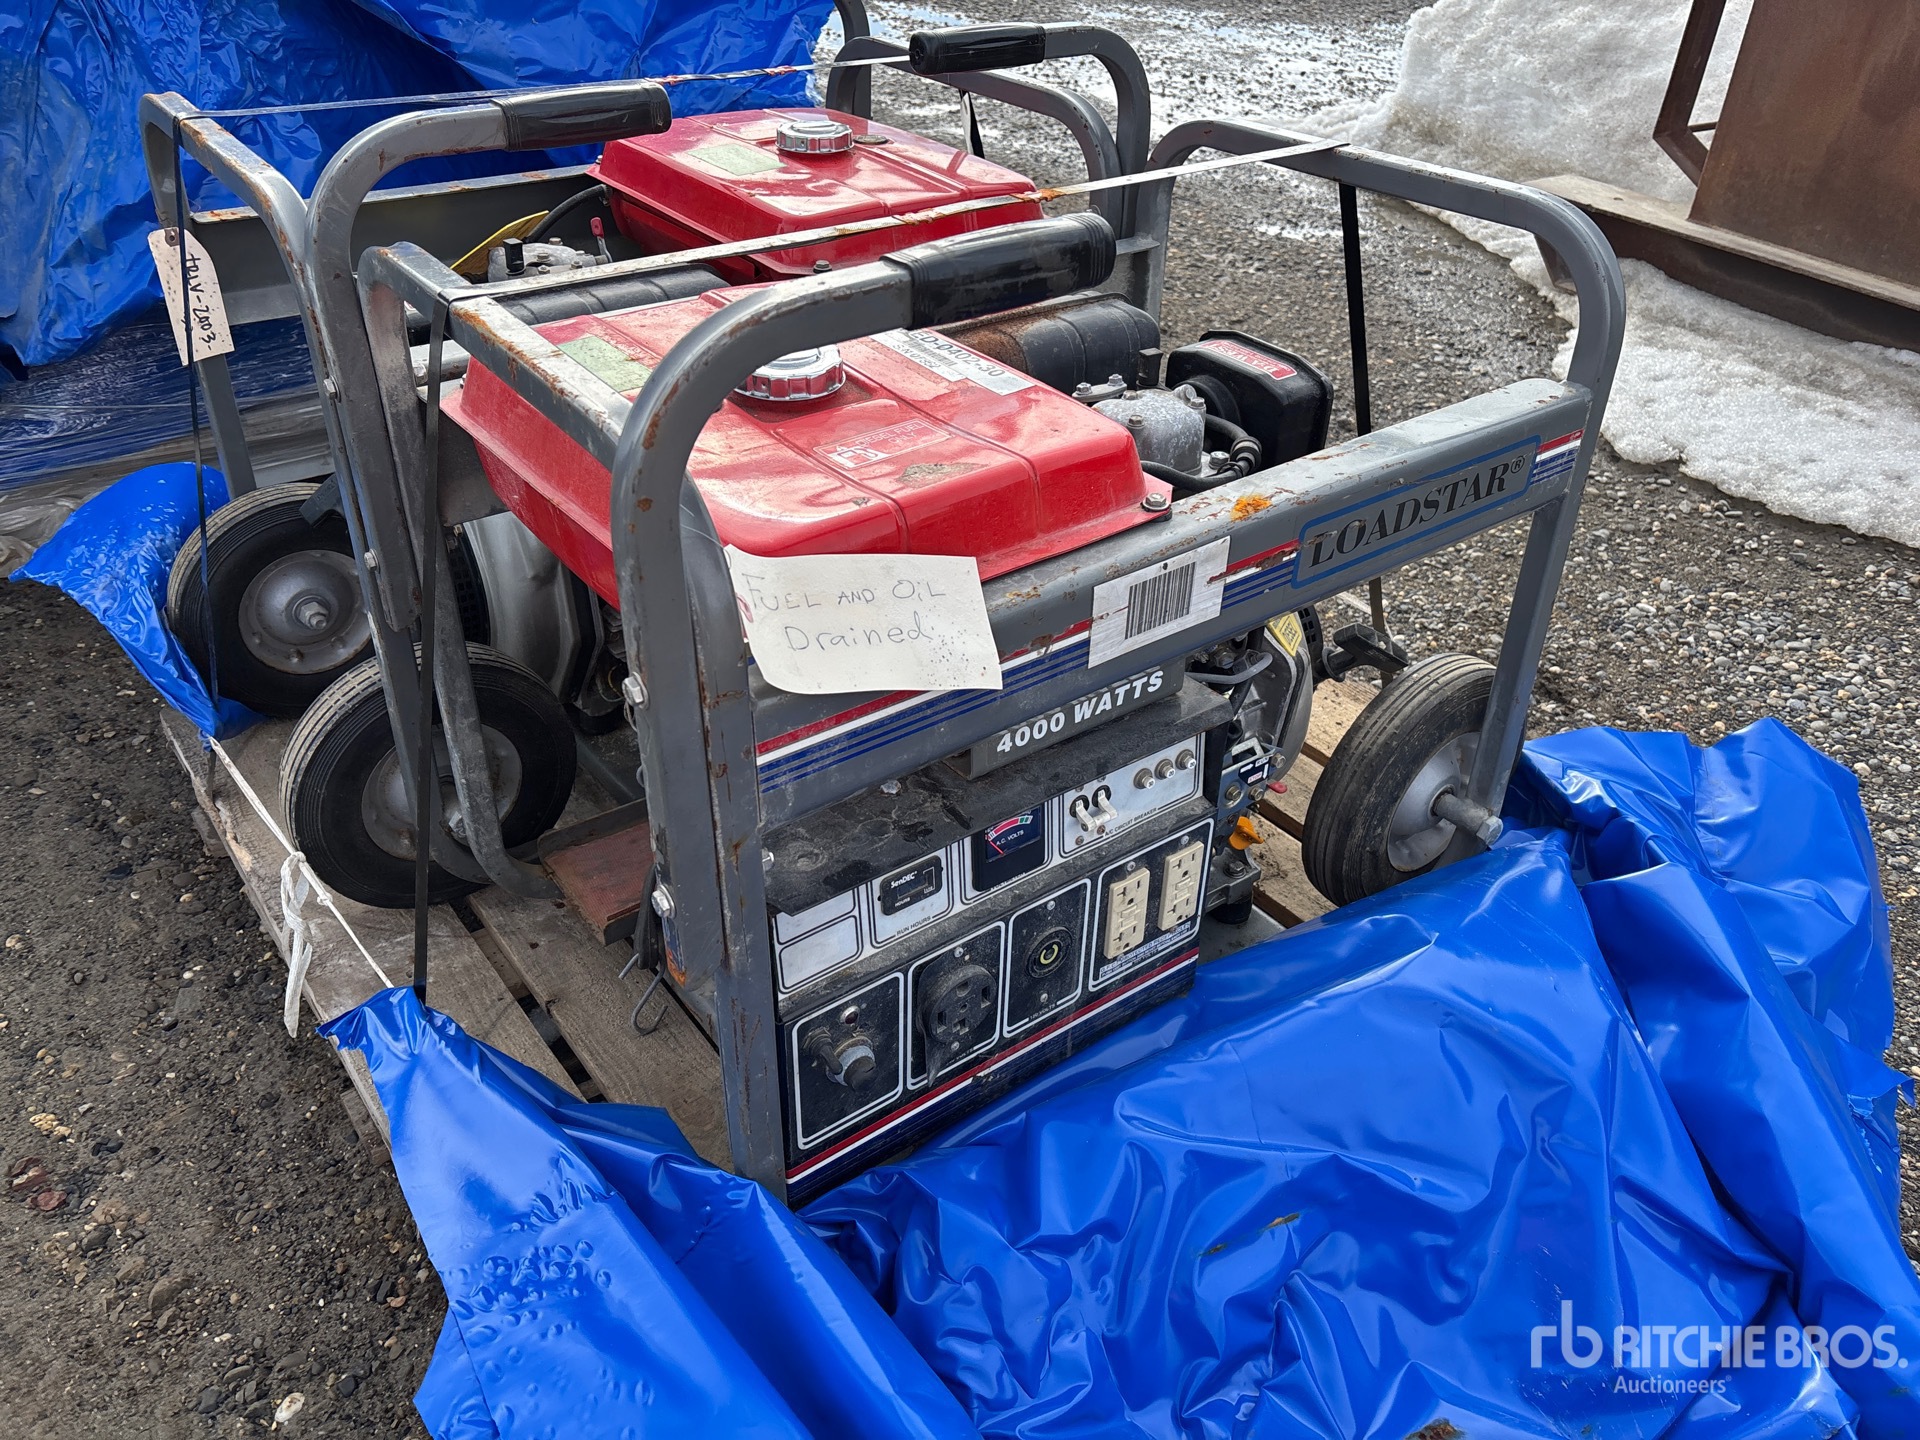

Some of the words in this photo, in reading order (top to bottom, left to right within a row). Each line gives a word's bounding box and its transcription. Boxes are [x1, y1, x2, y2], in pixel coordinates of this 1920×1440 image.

[893, 422, 926, 435] FUEL
[741, 572, 822, 612] FUEL
[837, 588, 876, 606] AND
[996, 712, 1066, 753] 4000
[1073, 669, 1164, 724] WATTS
[1007, 829, 1025, 841] VOLTS
[896, 927, 910, 937] RUN
[910, 915, 932, 930] HOURS
